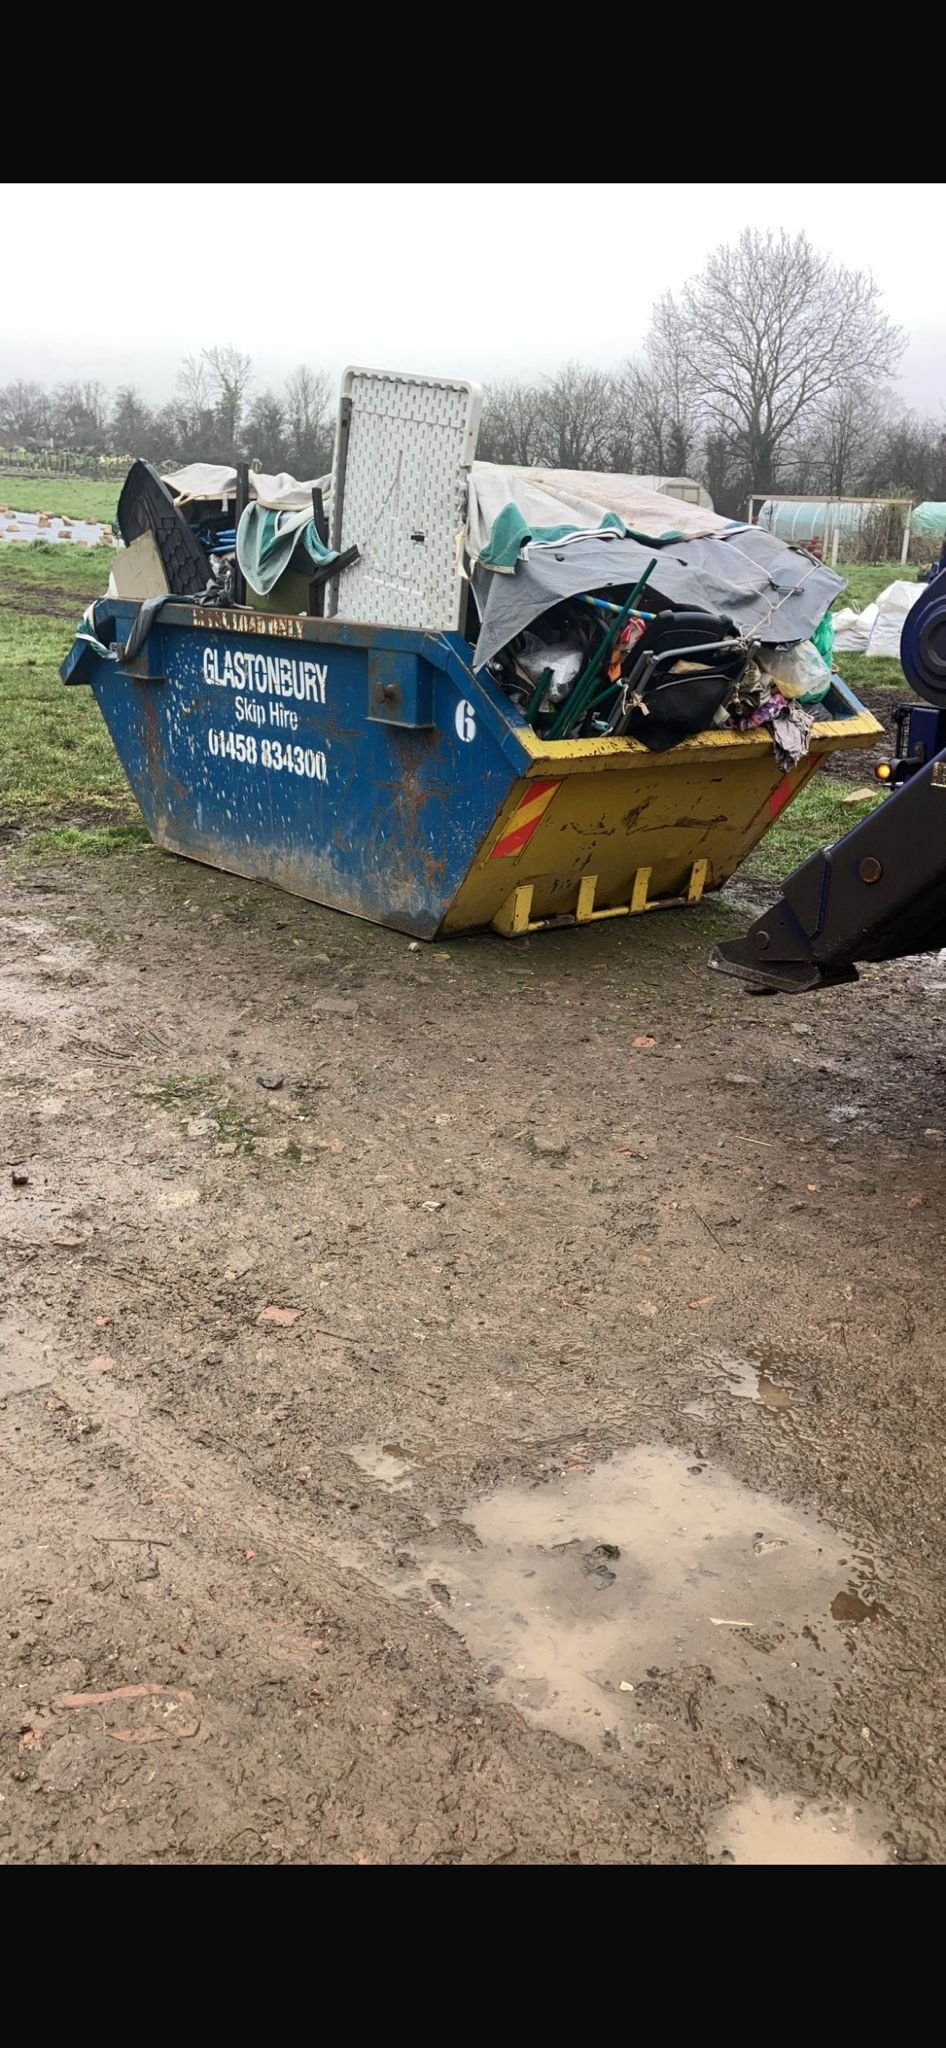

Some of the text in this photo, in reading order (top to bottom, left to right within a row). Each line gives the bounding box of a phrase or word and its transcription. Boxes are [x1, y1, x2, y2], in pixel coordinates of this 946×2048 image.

[203, 647, 328, 704] GLASTONBURY
[235, 696, 298, 731] Skip Hire
[455, 699, 477, 743] 6
[208, 728, 327, 781] 01458 834300
